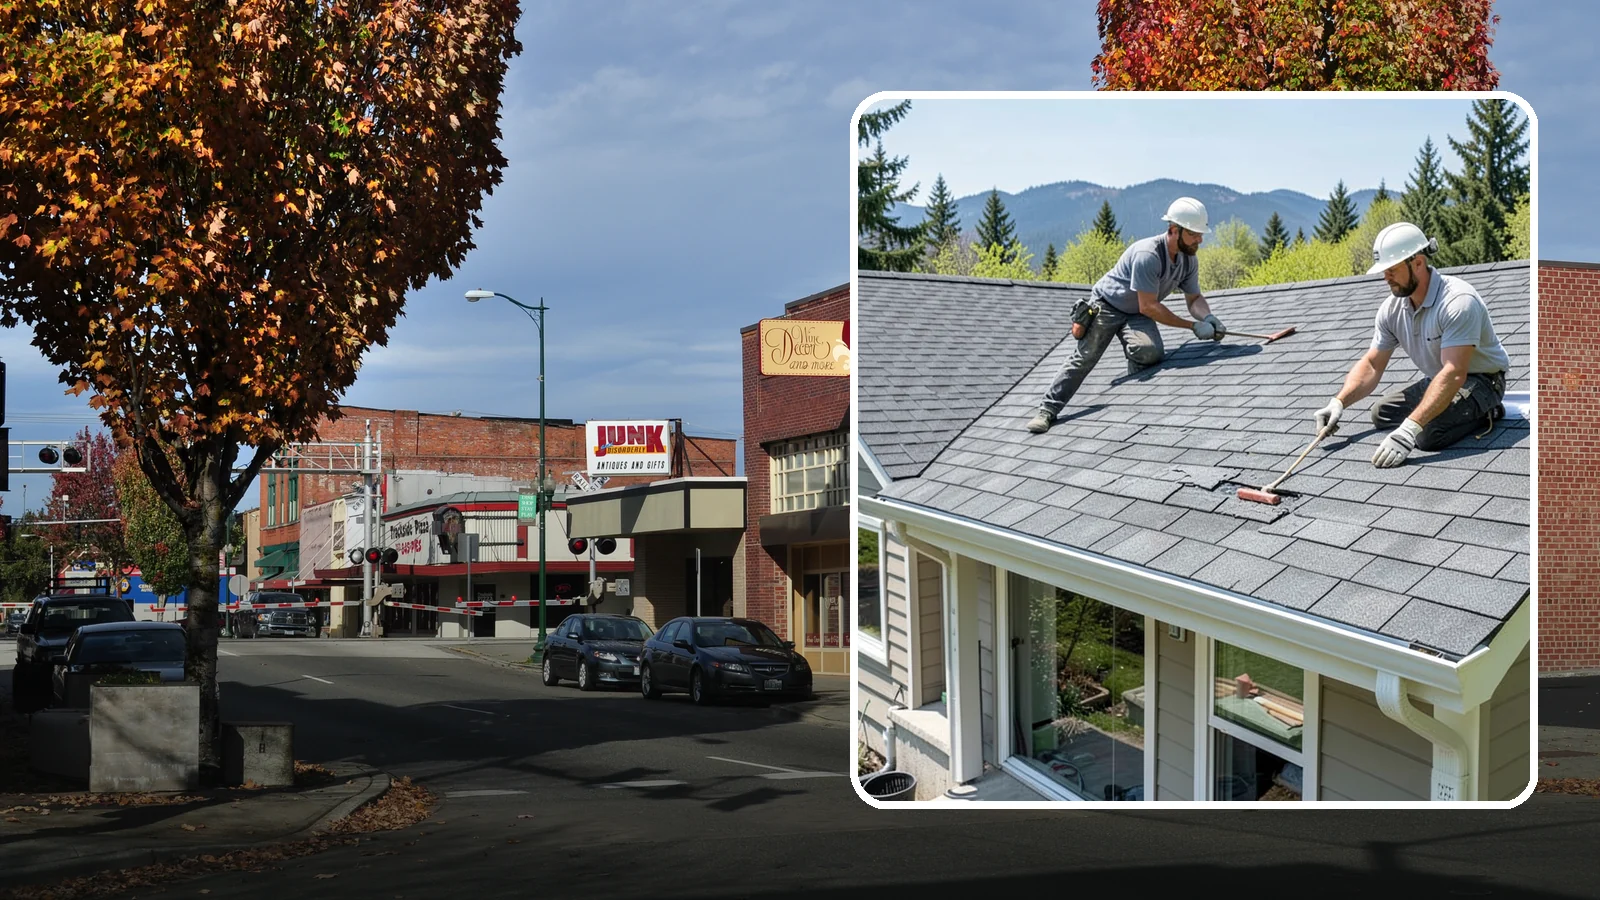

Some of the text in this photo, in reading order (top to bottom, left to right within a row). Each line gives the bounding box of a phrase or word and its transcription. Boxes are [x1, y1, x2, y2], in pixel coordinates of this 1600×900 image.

[764, 327, 831, 365] Decor
[596, 425, 665, 457] JUNK
[607, 446, 646, 454] DISORDERLY
[597, 461, 665, 470] ANTIQUES AND GIFTS
[414, 519, 429, 535] Pizza
